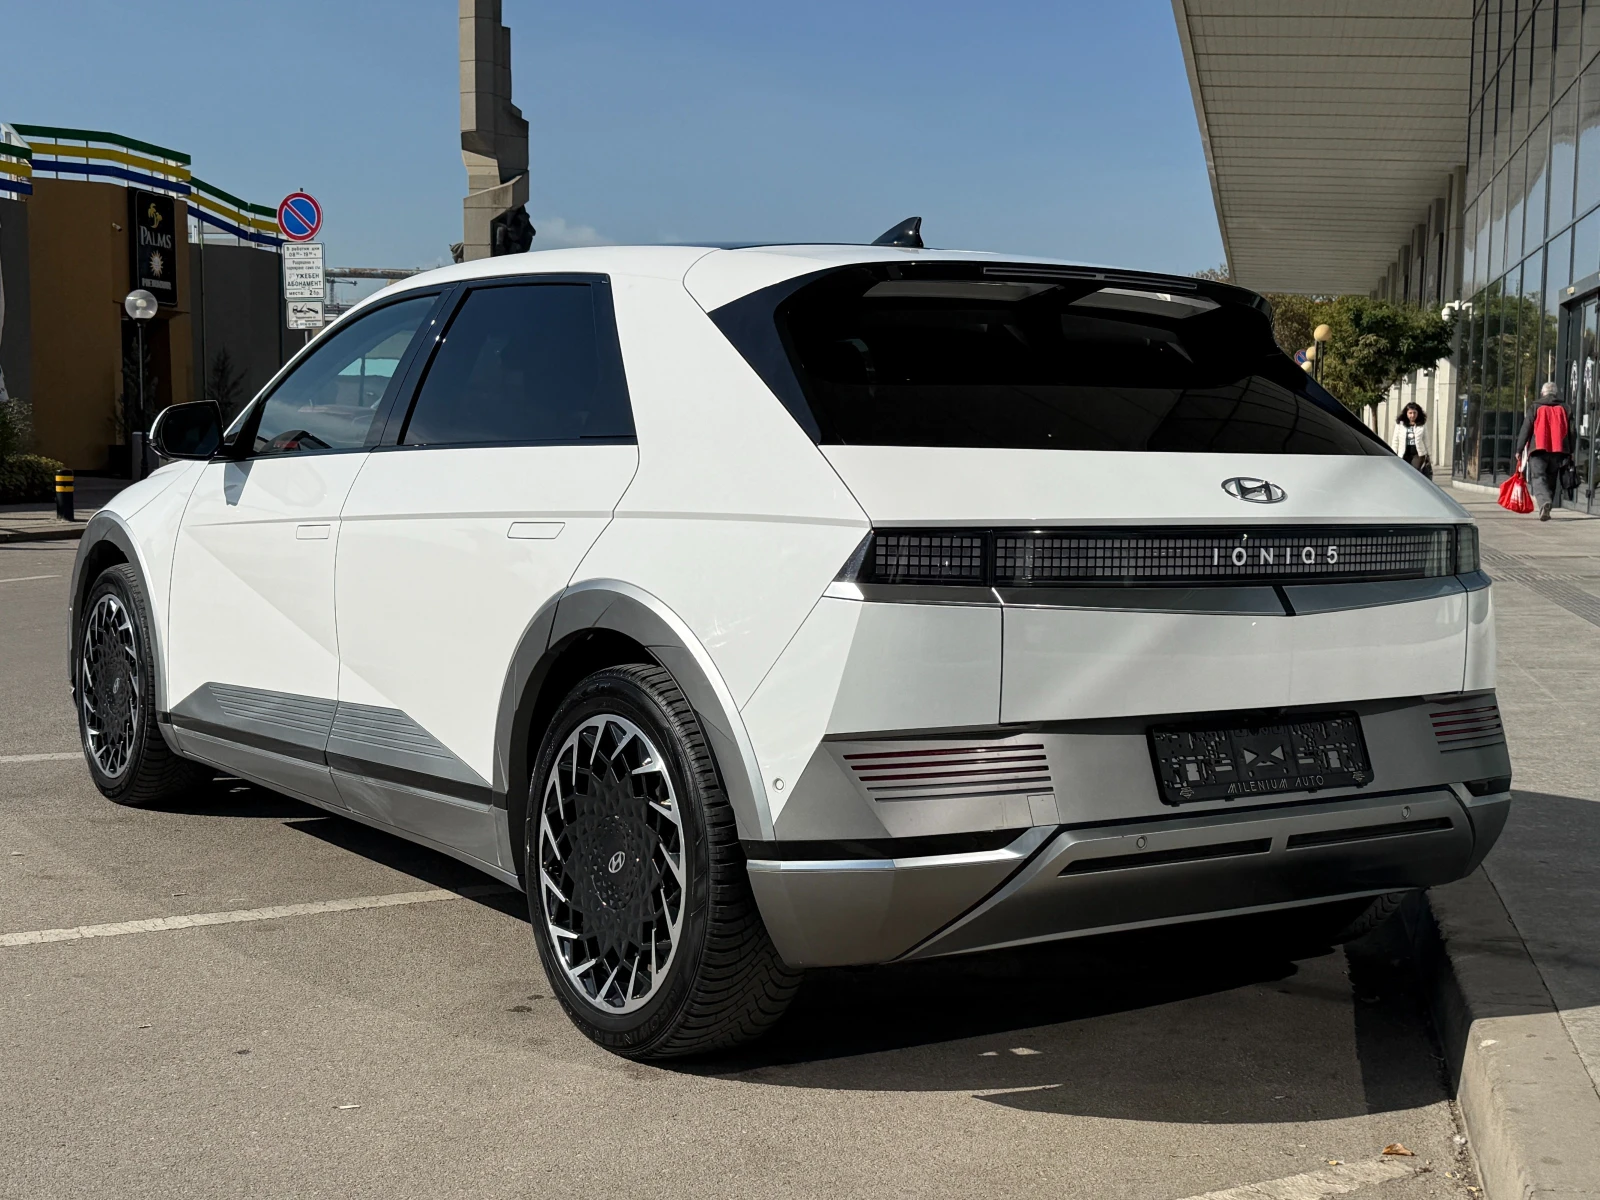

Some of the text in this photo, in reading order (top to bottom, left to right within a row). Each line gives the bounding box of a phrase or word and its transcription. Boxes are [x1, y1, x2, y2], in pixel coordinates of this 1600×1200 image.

[140, 225, 172, 249] PALMS
[1227, 775, 1325, 794] MILENIUM AUTO
